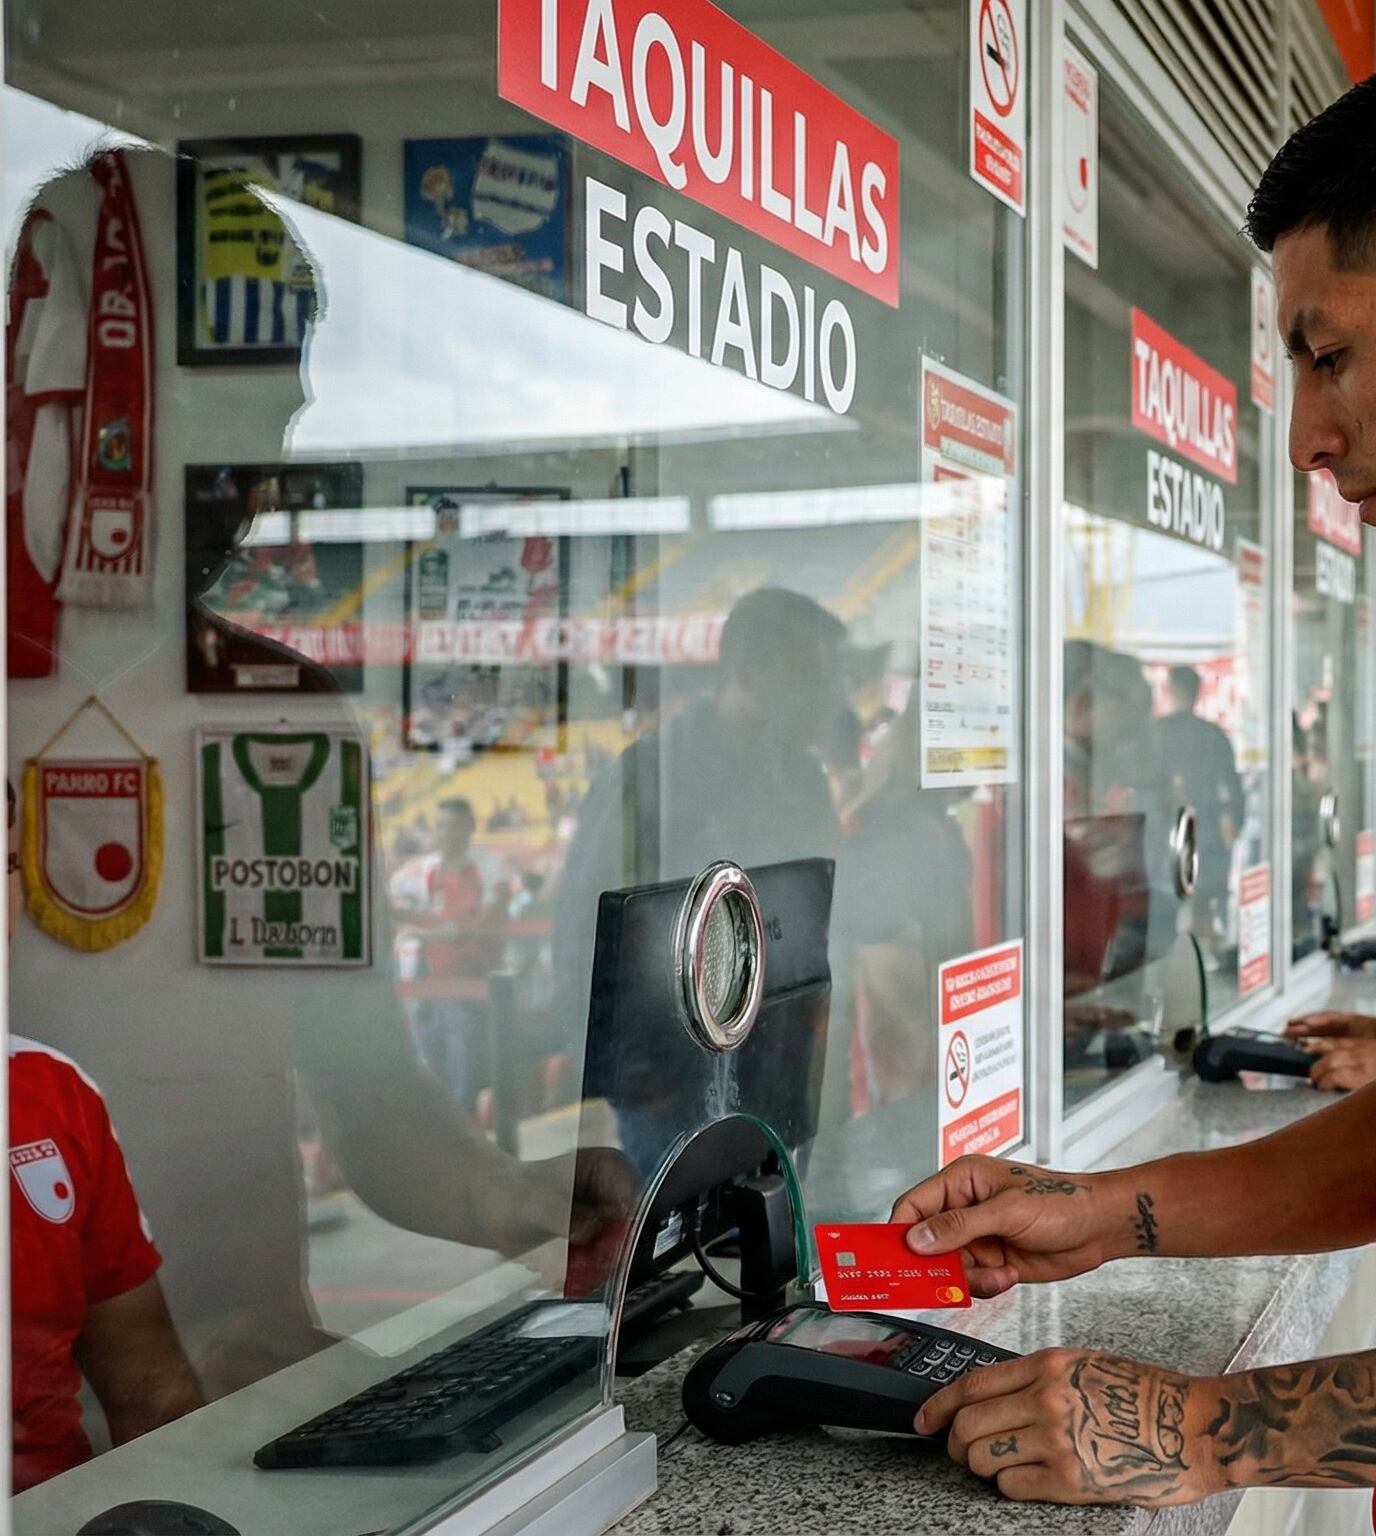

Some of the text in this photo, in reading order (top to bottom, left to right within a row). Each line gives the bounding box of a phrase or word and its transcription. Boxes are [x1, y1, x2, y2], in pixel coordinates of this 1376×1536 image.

[586, 176, 857, 415] ESTADIO
[1134, 336, 1234, 469] TAQUILLAS
[1147, 448, 1226, 551] ESTADIO
[214, 858, 351, 888] POSTOBON
